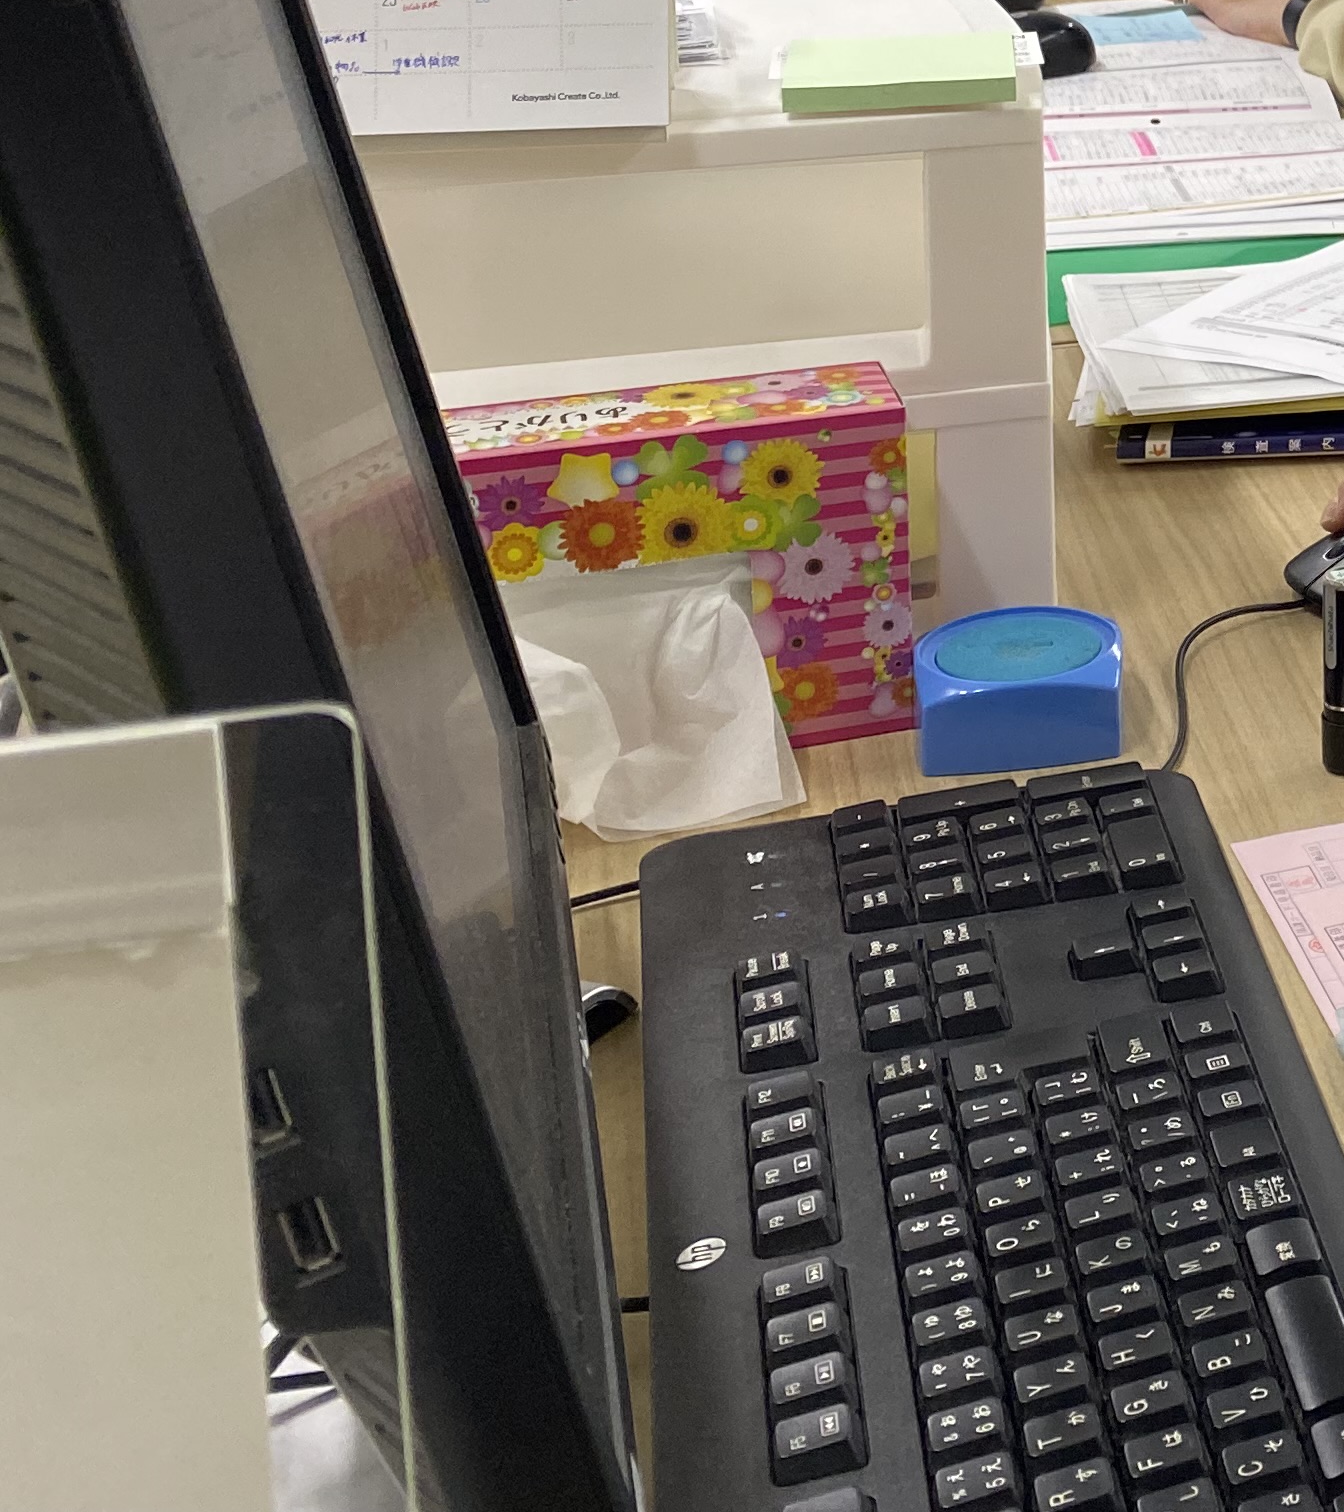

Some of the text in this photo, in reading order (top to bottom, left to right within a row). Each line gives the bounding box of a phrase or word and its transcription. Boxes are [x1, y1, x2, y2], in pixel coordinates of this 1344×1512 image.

[512, 93, 556, 102] Kobayashi
[557, 92, 587, 101] Create
[1222, 437, 1335, 455] 検査案内
[1053, 841, 1070, 850] 2
[988, 851, 1005, 860] 5
[919, 862, 936, 870] 8
[1128, 859, 1146, 867] 0
[925, 892, 943, 900] 7
[758, 1090, 772, 1103] F12
[761, 1129, 775, 1143] F11
[765, 1169, 779, 1184] F10
[988, 1197, 1010, 1207] P
[769, 1216, 784, 1229] F9
[1079, 1210, 1101, 1224] L
[996, 1238, 1018, 1250] O
[1088, 1254, 1112, 1270] K
[1178, 1258, 1202, 1276] M
[951, 1272, 969, 1282] 9
[1100, 1303, 1122, 1314] J
[1192, 1305, 1216, 1320] N
[958, 1320, 977, 1330] 8
[779, 1333, 795, 1345] F7
[1017, 1330, 1042, 1345] U
[1110, 1348, 1136, 1365] H
[1207, 1355, 1232, 1371] B
[966, 1371, 985, 1381] 7
[1026, 1384, 1052, 1397] Y
[1123, 1398, 1148, 1416] G
[1221, 1408, 1247, 1423] V
[975, 1422, 995, 1434] 6
[790, 1436, 806, 1450] F5
[1037, 1437, 1063, 1450] T
[1137, 1459, 1164, 1472] F
[1238, 1460, 1263, 1477] C
[985, 1477, 1007, 1489] 5
[1049, 1489, 1075, 1508] R
